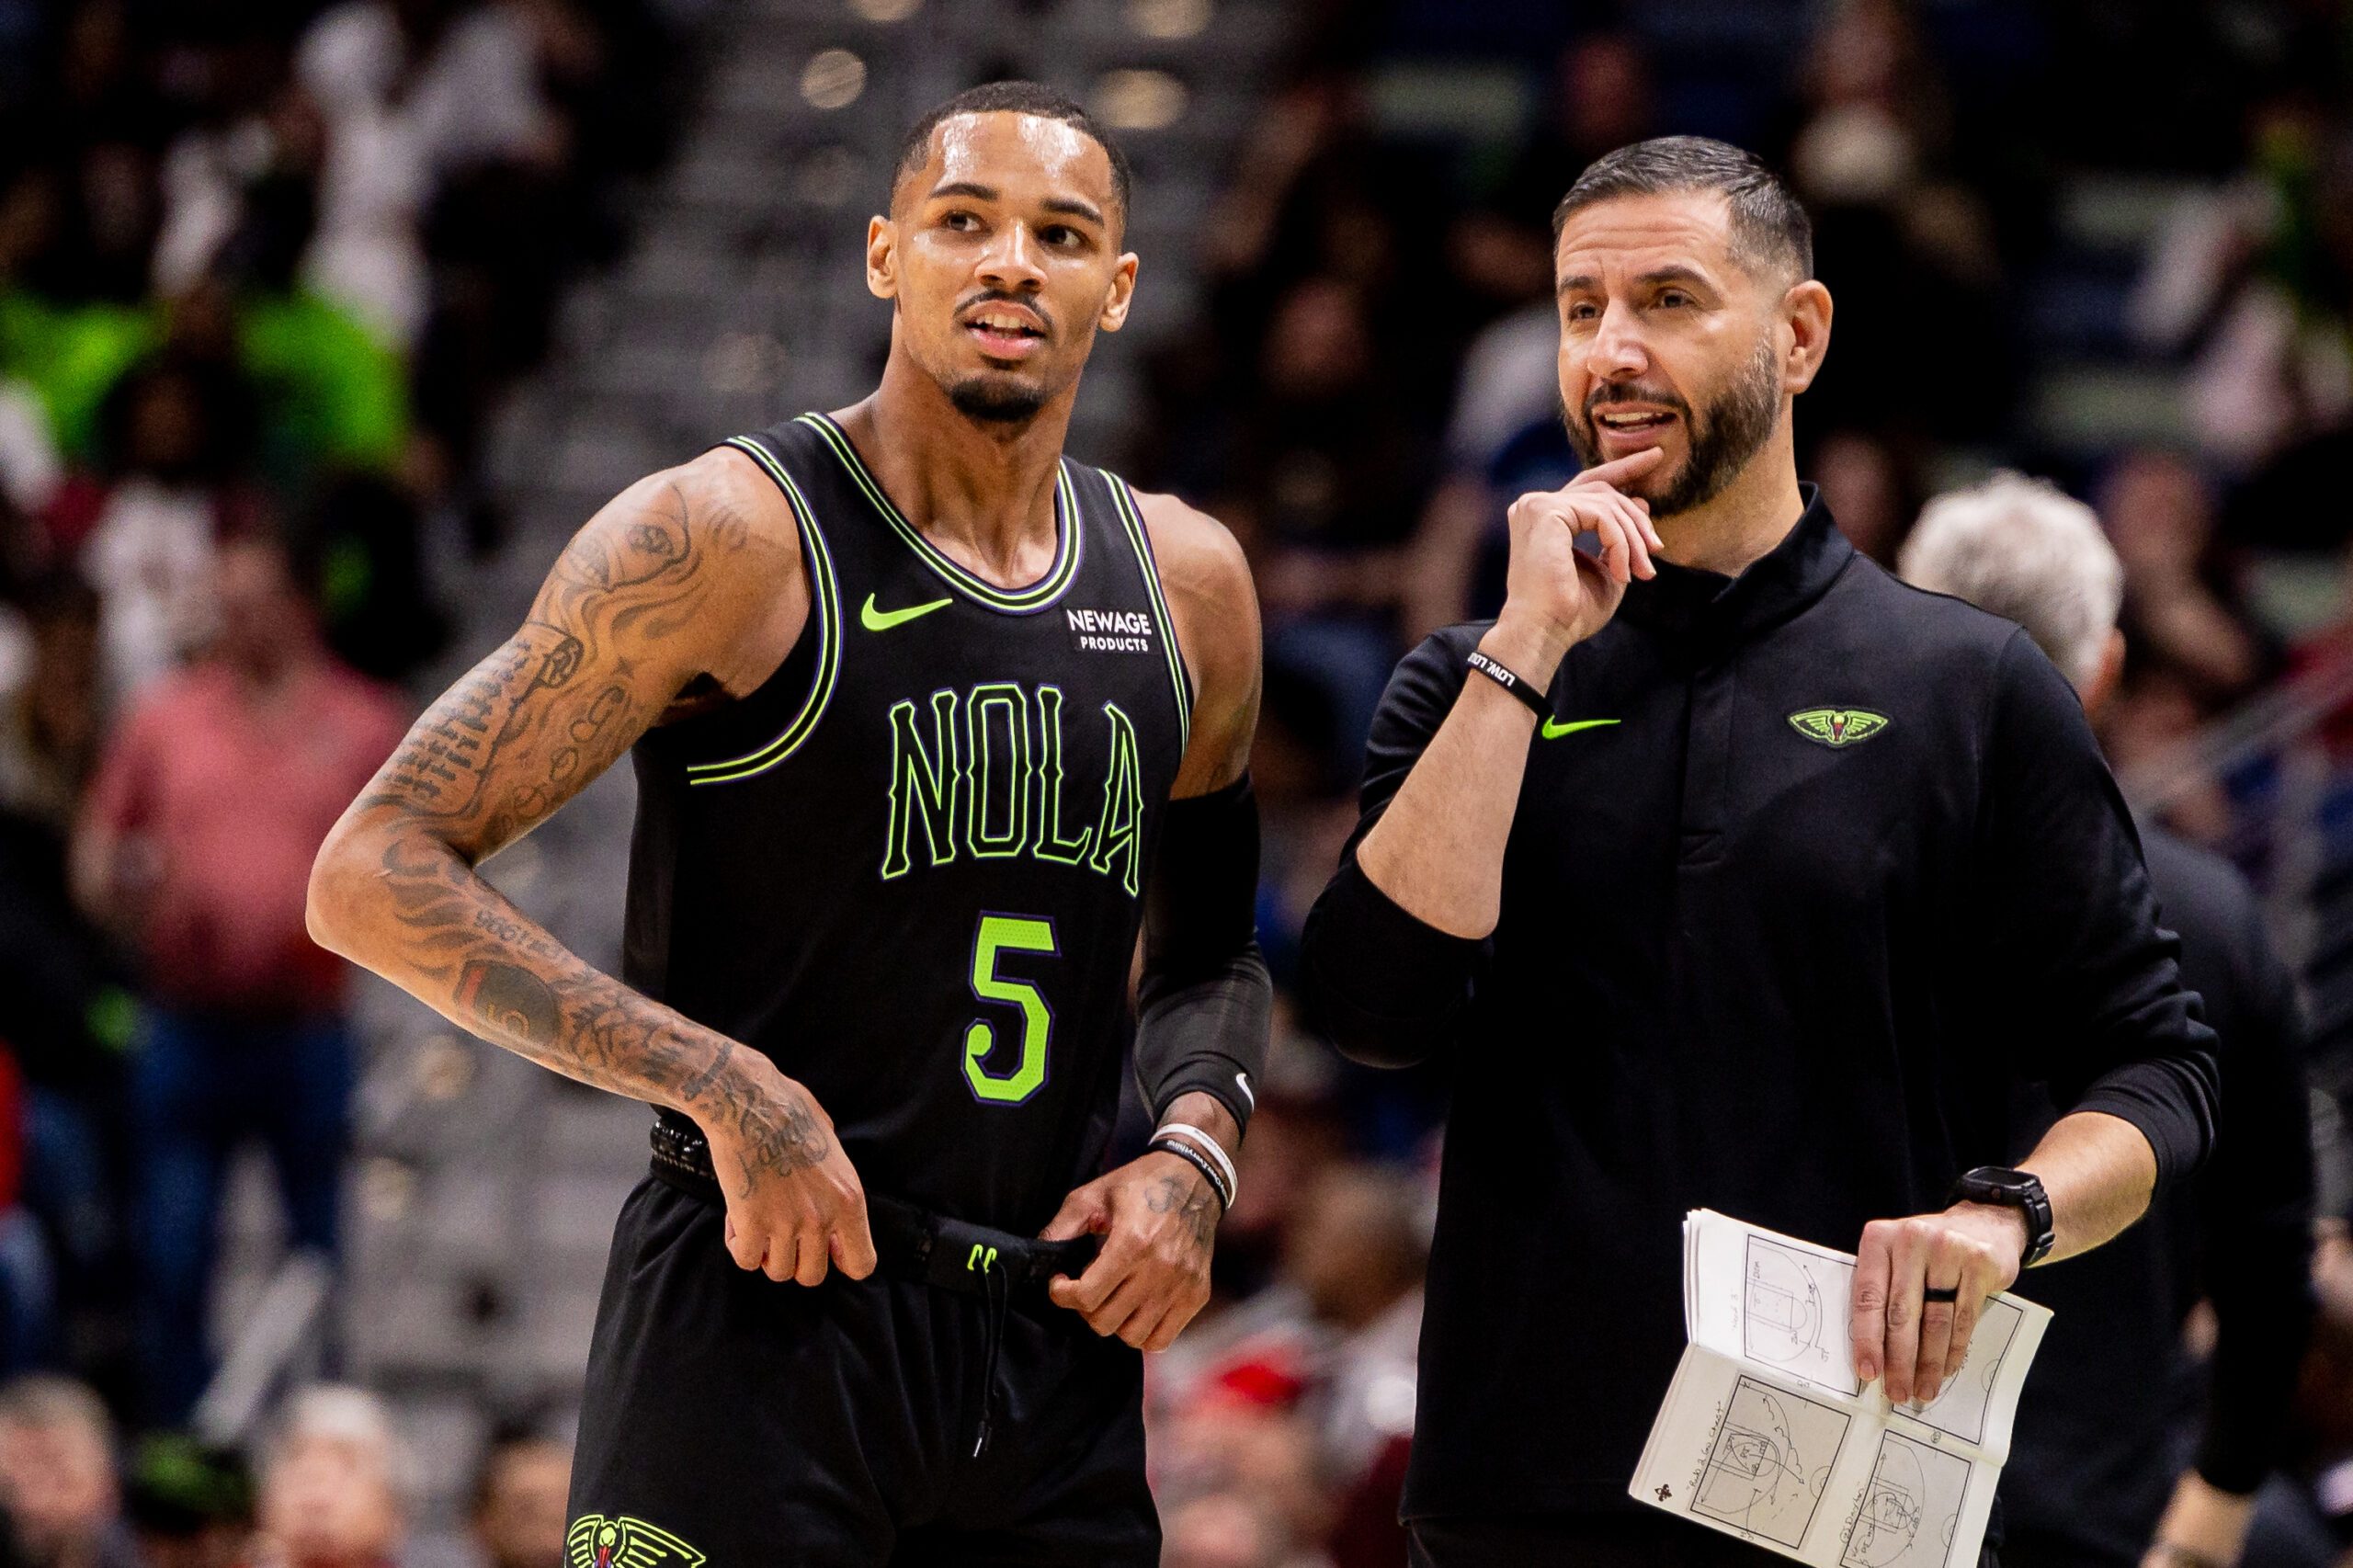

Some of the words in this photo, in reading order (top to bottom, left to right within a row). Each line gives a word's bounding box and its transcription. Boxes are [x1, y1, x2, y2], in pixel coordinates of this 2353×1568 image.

[1066, 608, 1153, 635] NEWAGE
[1080, 636, 1149, 653] PRODUCTS
[881, 684, 1144, 897] NOLA
[963, 913, 1058, 1105] 5
